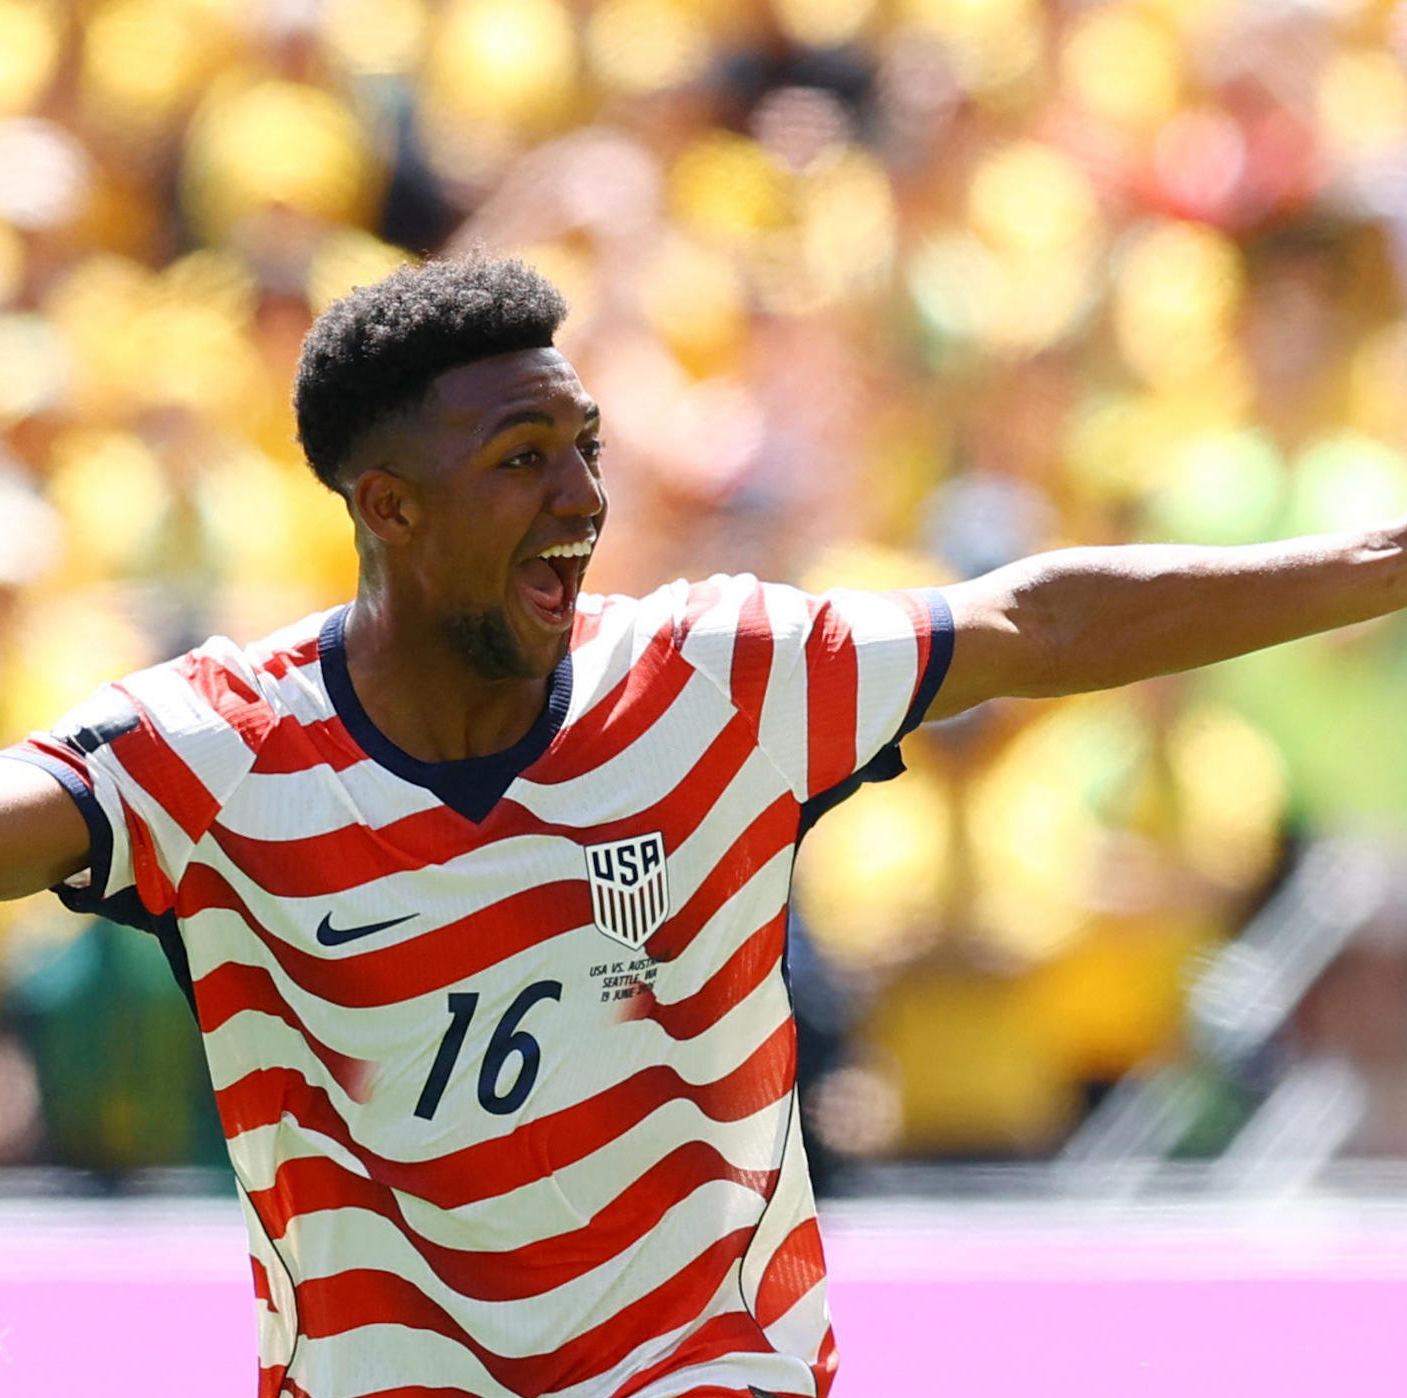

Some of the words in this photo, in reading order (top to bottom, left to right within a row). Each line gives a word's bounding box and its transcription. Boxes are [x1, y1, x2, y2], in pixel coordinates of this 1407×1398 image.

[592, 839, 660, 886] USA
[590, 964, 608, 977] USA
[413, 980, 563, 1121] 16
